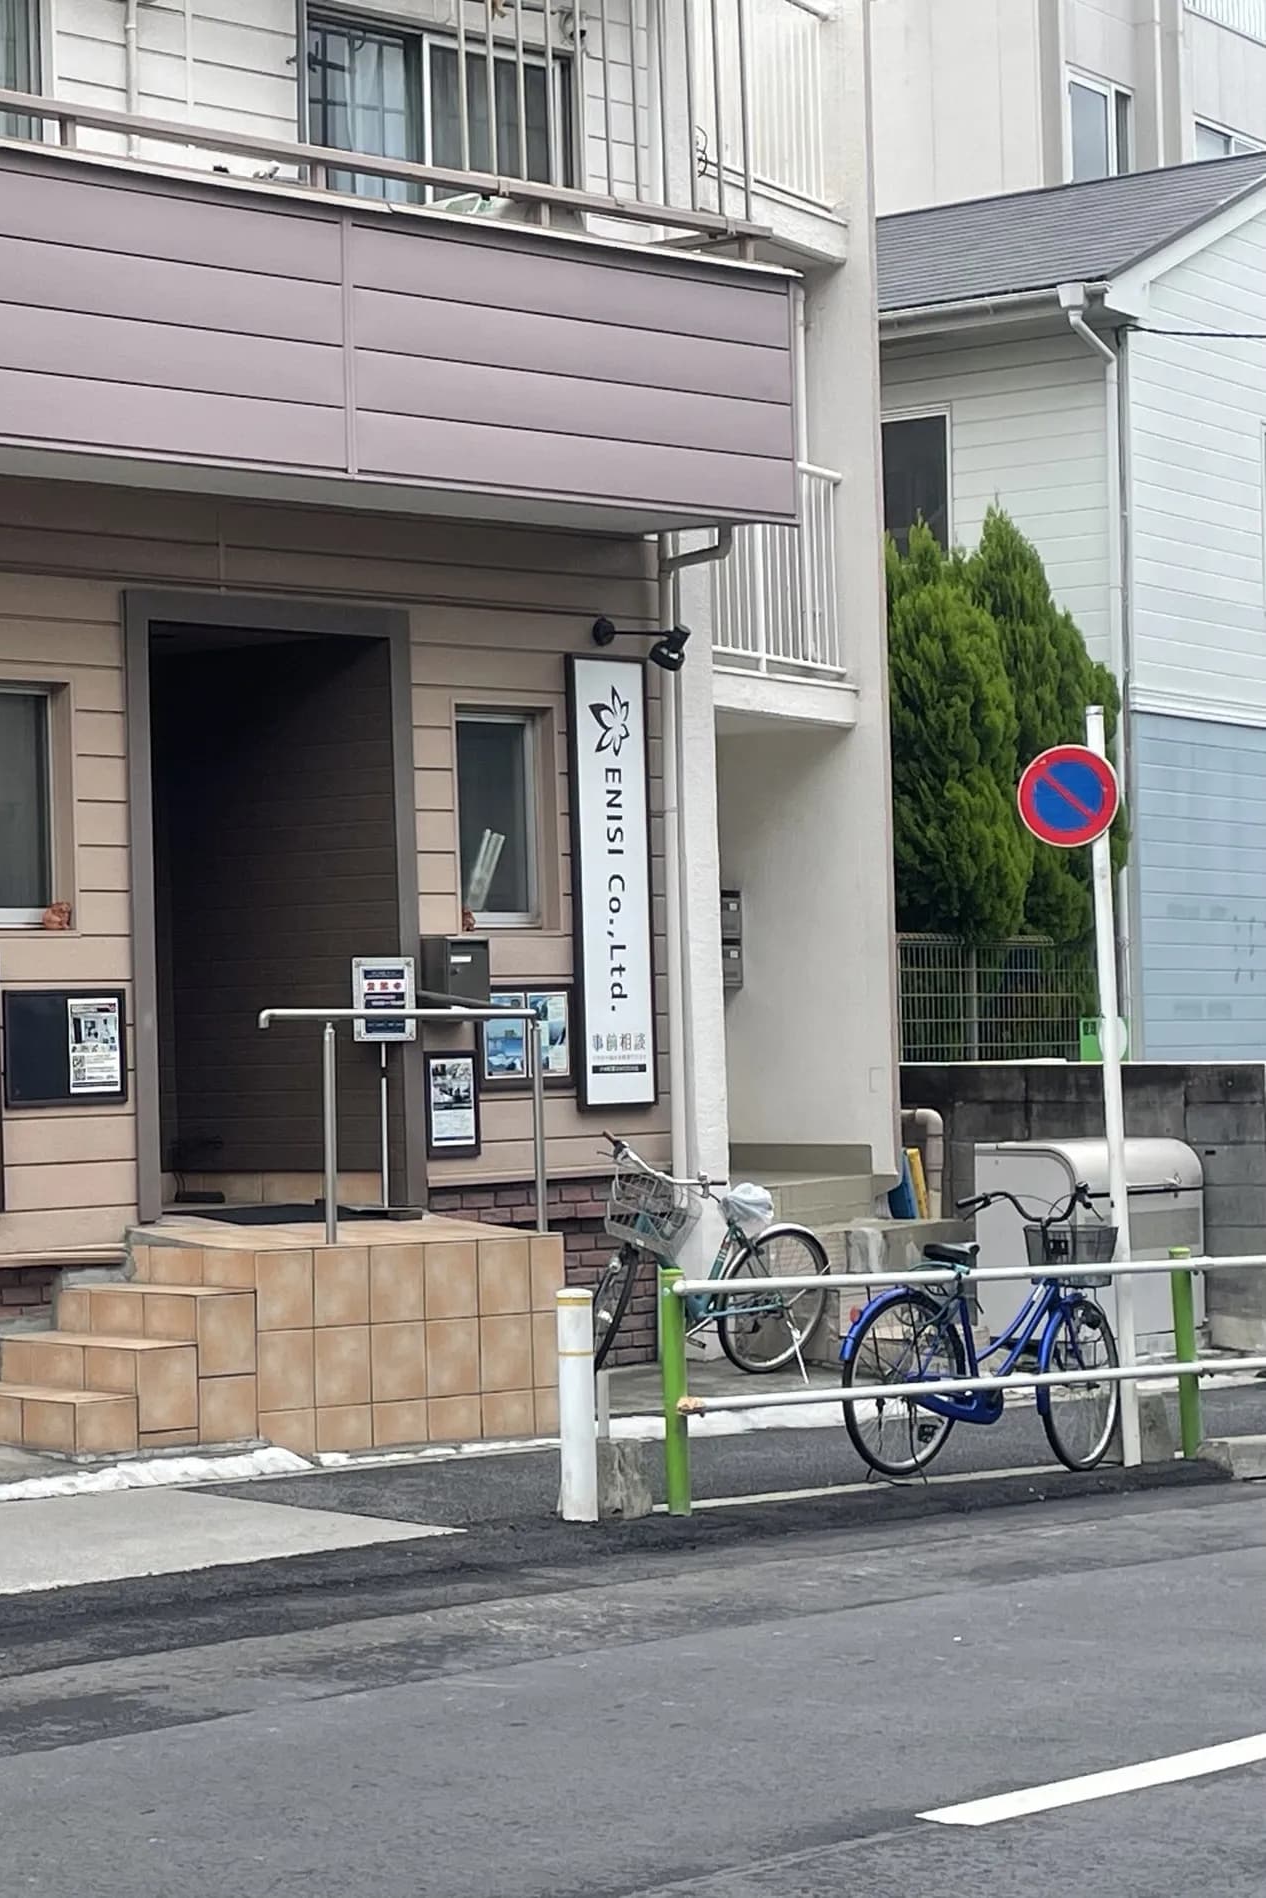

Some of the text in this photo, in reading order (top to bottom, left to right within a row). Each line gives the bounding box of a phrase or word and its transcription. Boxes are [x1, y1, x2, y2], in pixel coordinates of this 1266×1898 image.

[604, 767, 628, 1012] ENISI Co.,Ltd.
[592, 1032, 646, 1052] 事前相談
